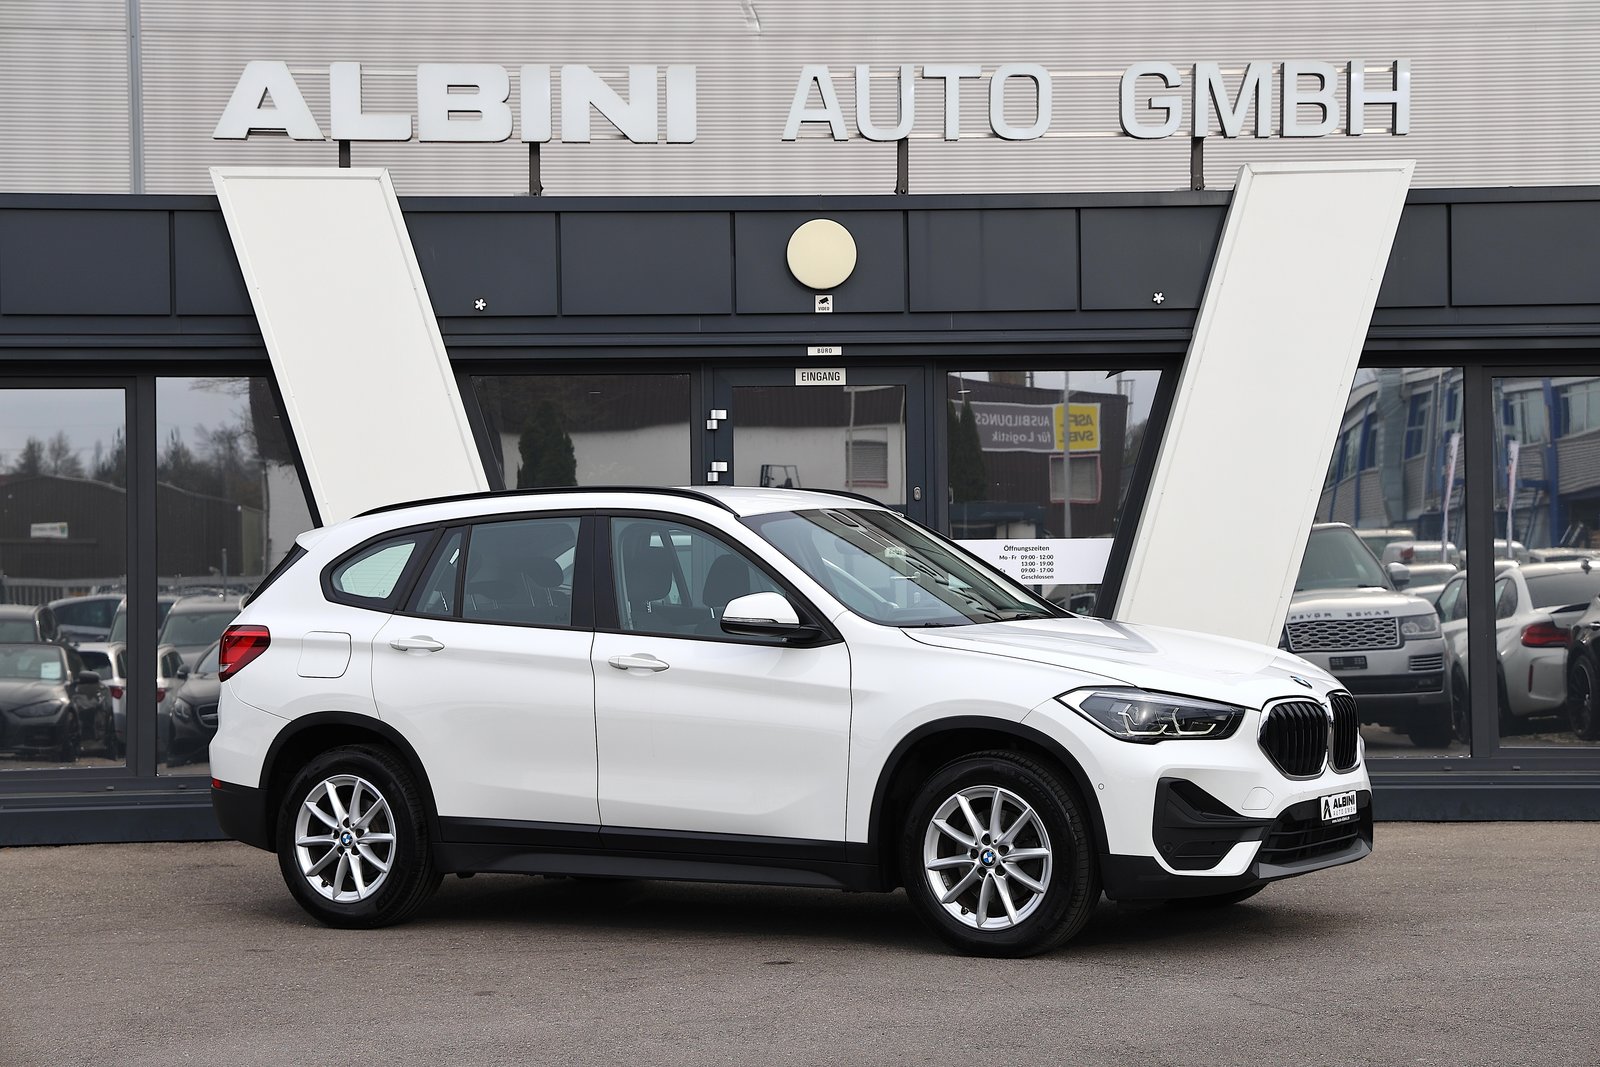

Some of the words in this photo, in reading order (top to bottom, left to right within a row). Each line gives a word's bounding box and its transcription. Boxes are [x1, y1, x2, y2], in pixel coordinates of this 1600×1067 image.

[213, 60, 697, 144] ALBINI
[781, 62, 1053, 142] AUTO
[1119, 60, 1412, 139] GMBH
[801, 371, 841, 382] EINGANG
[1333, 794, 1355, 809] ALBINI
